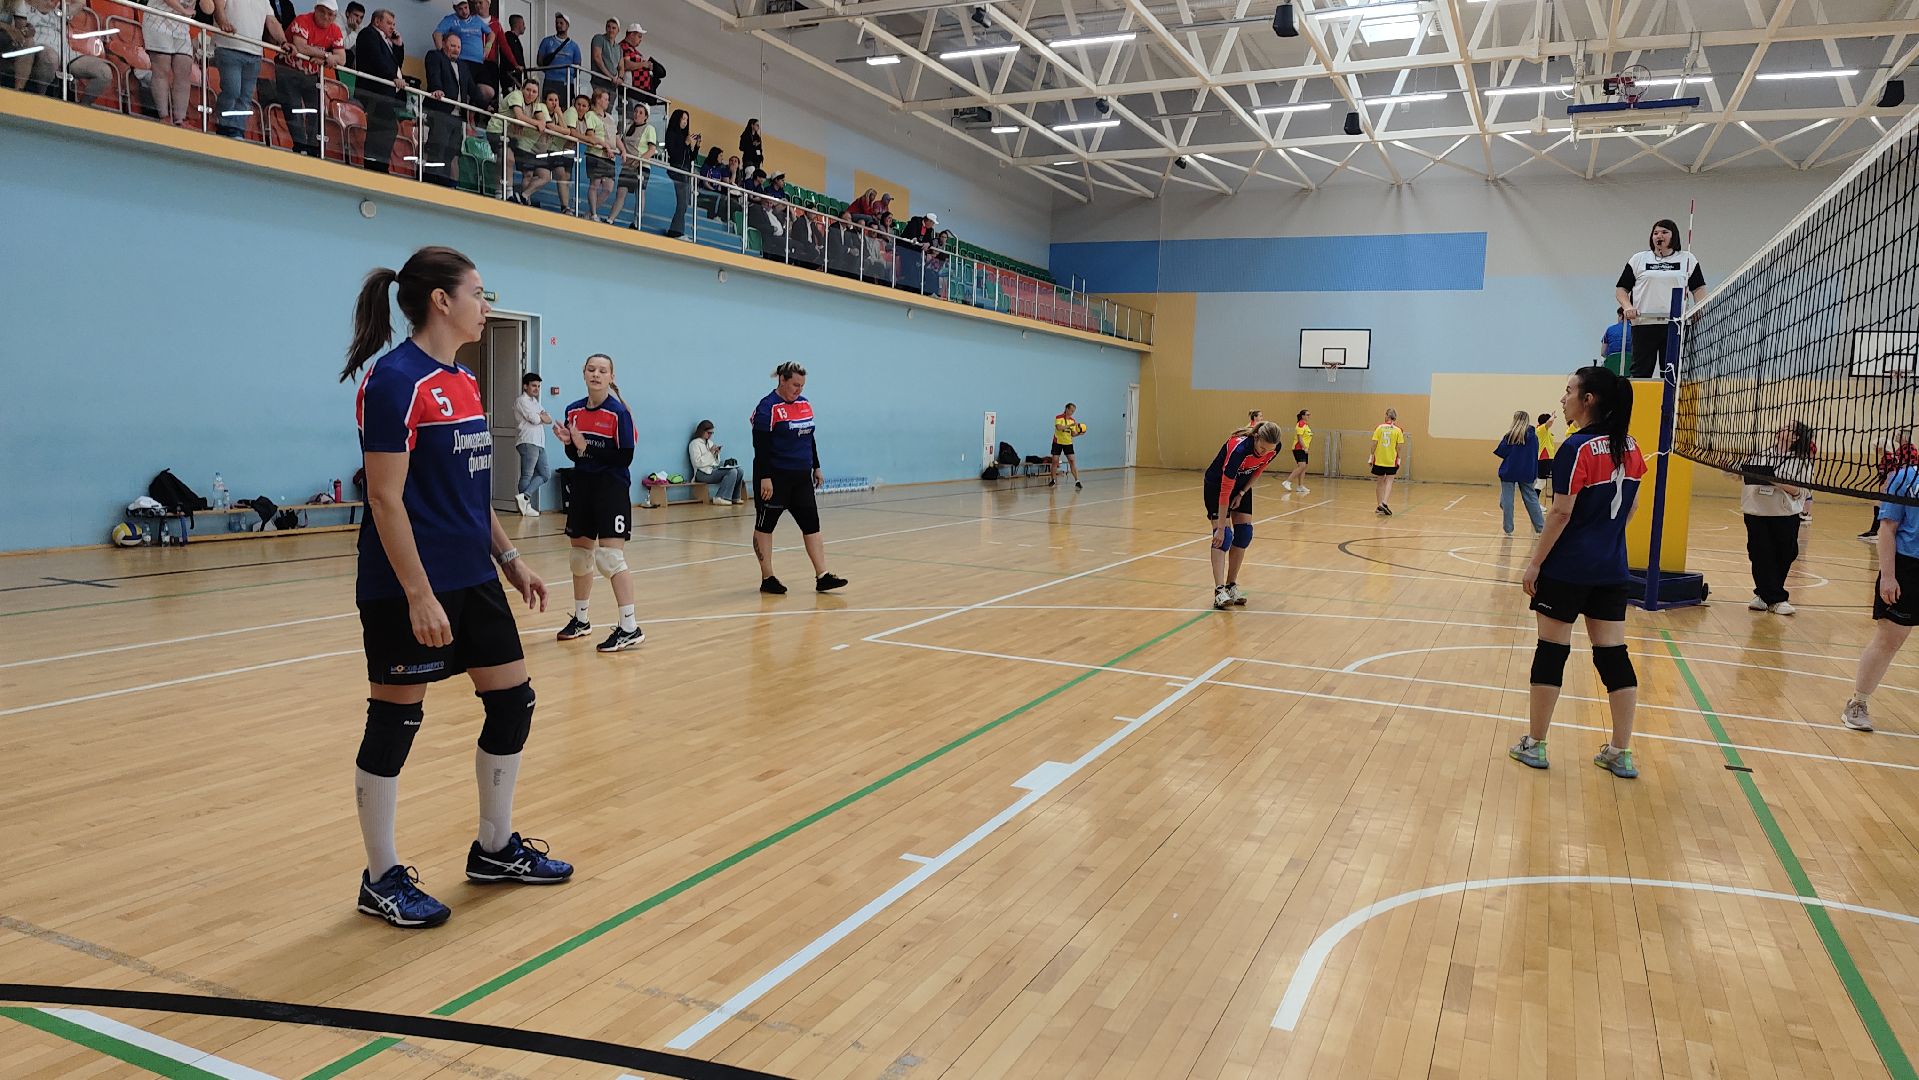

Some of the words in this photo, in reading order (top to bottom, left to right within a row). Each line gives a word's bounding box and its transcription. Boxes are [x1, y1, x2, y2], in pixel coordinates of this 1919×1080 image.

[430, 387, 454, 417] 5
[1382, 431, 1392, 448] 5
[614, 514, 626, 534] 6
